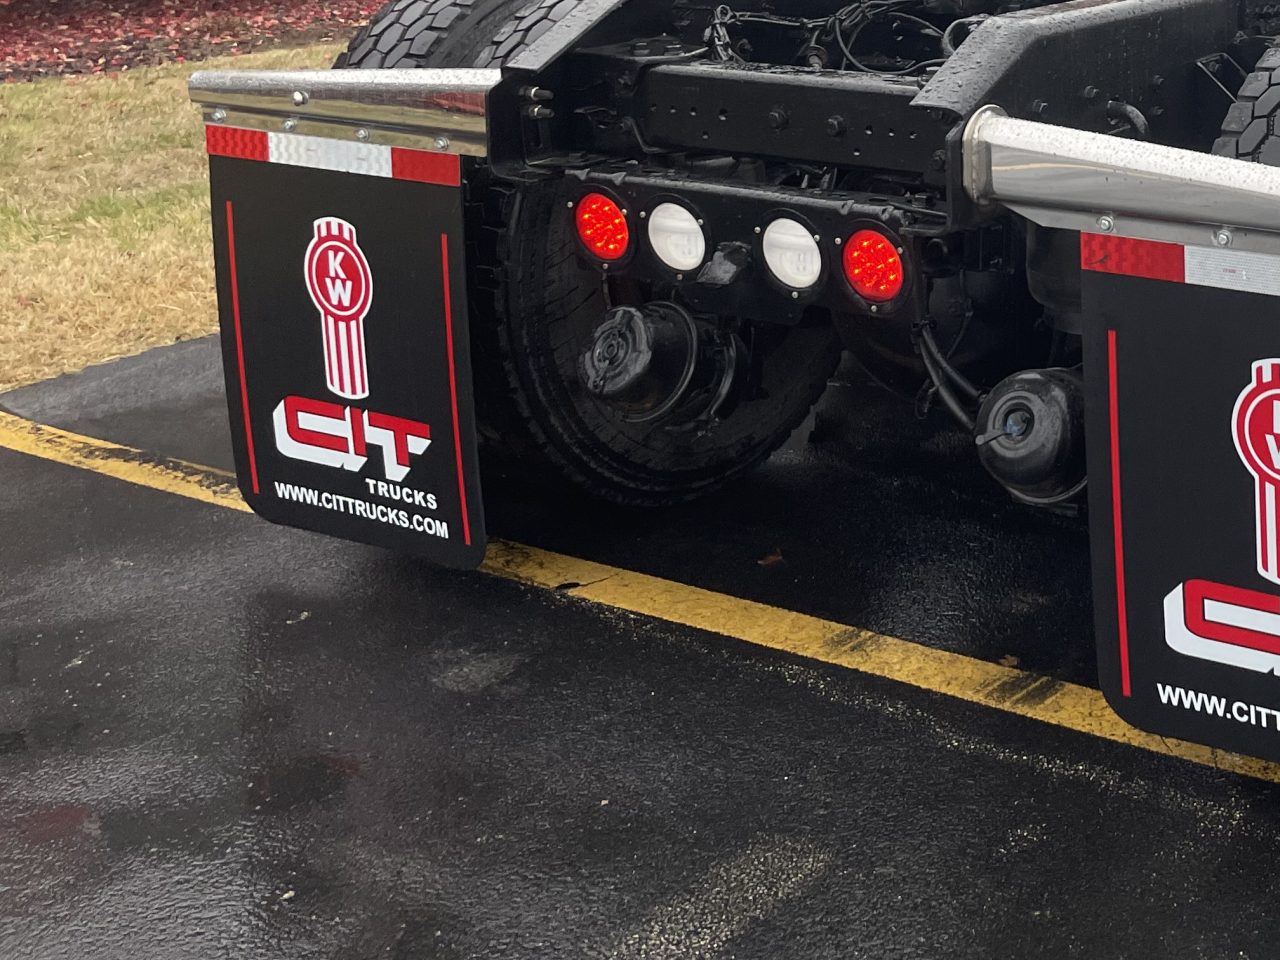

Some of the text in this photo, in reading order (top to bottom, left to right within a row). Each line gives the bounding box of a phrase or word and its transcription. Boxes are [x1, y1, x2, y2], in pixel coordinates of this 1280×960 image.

[328, 250, 347, 279] K
[325, 277, 352, 306] W
[273, 395, 431, 482] CIT
[274, 481, 449, 539] WWW.CITTRUCKS.COM
[365, 478, 438, 510] TRUCKS
